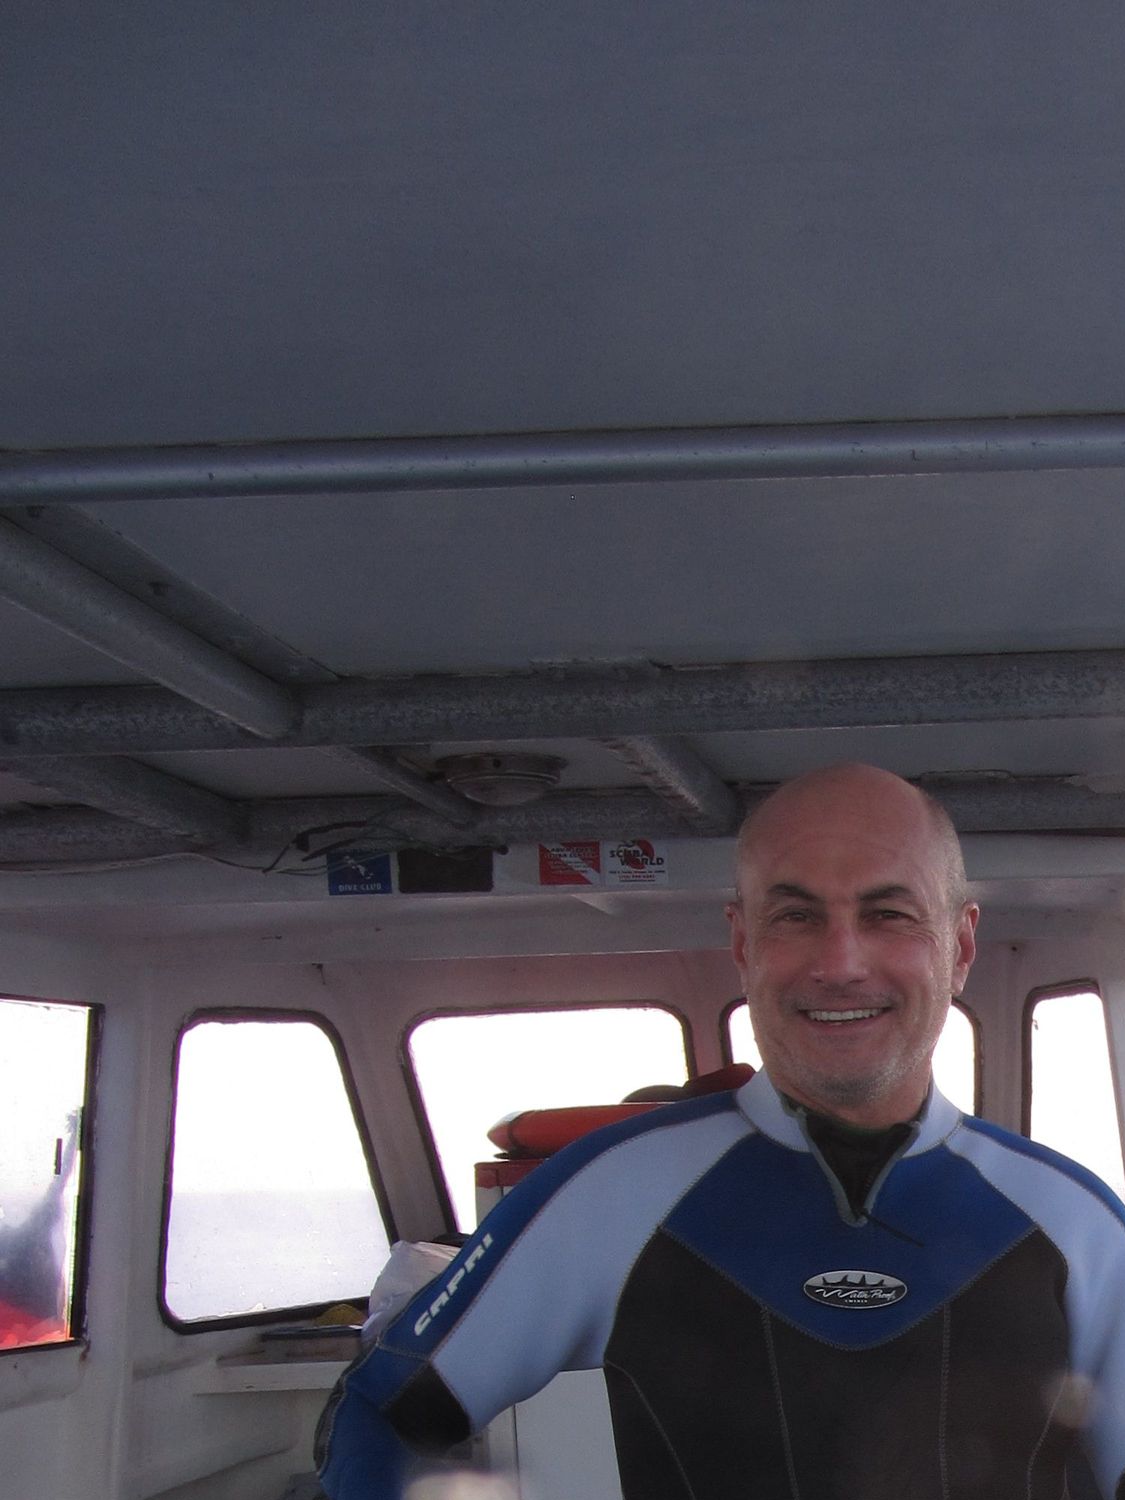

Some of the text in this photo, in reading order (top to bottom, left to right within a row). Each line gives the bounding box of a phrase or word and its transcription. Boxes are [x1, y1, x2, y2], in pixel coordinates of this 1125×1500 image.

[620, 857, 664, 866] WORLD
[338, 882, 382, 892] DIVE CLUB
[414, 1233, 493, 1336] CAPRI
